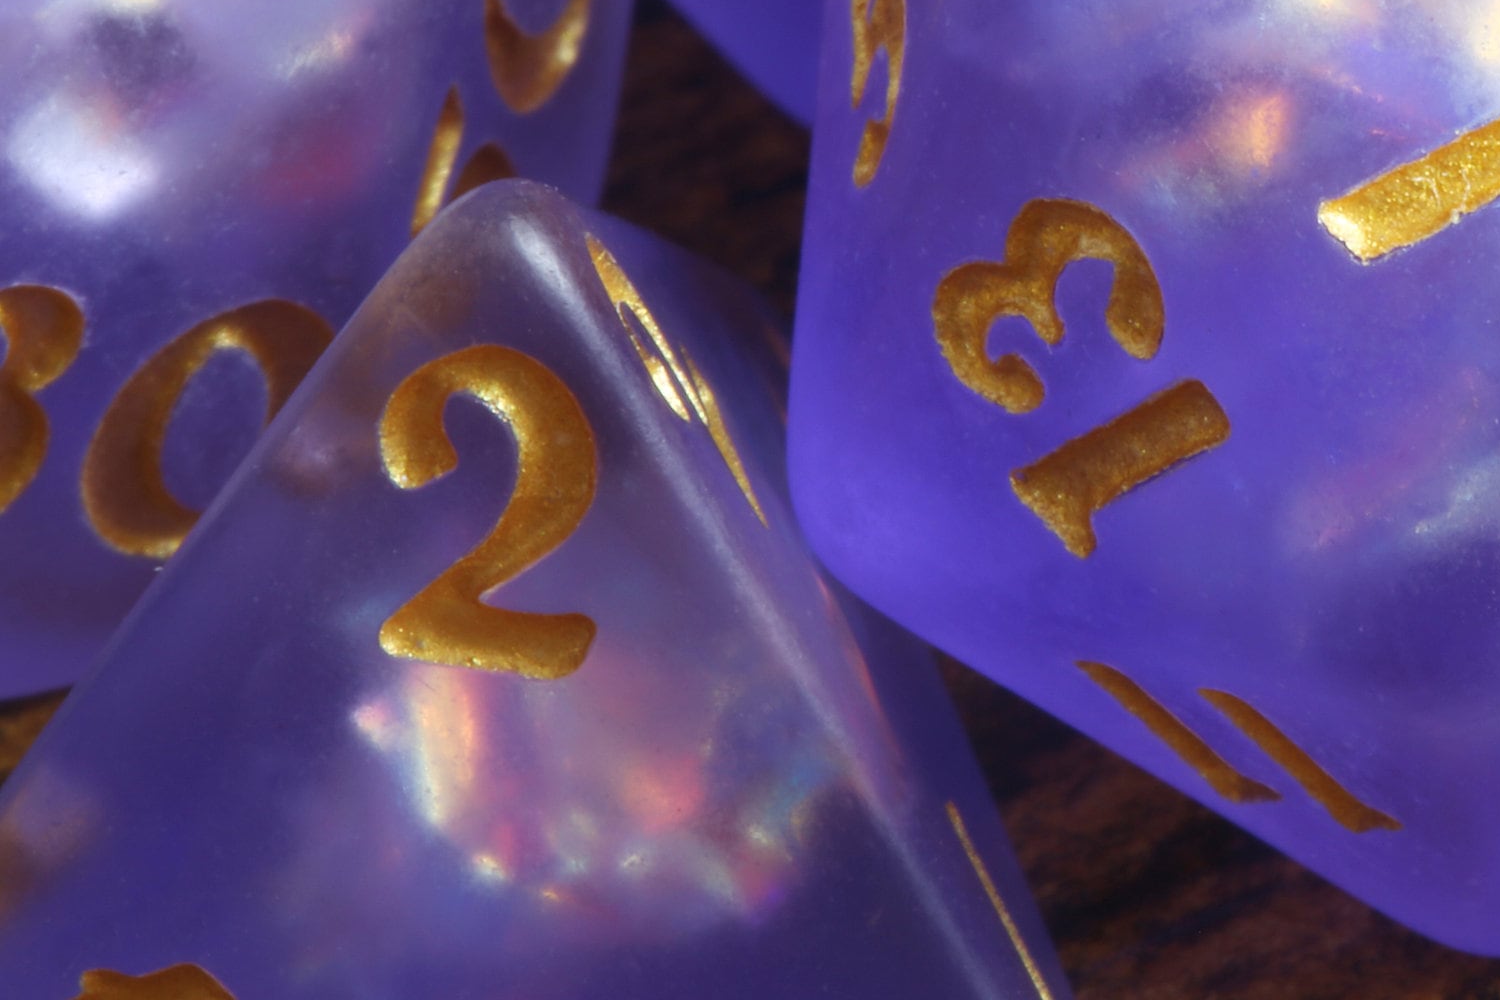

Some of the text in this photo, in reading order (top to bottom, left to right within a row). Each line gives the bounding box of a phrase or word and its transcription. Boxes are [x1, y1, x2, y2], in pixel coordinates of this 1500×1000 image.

[378, 344, 597, 680] 2
[931, 196, 1231, 560] 13
[1075, 660, 1402, 834] 11
